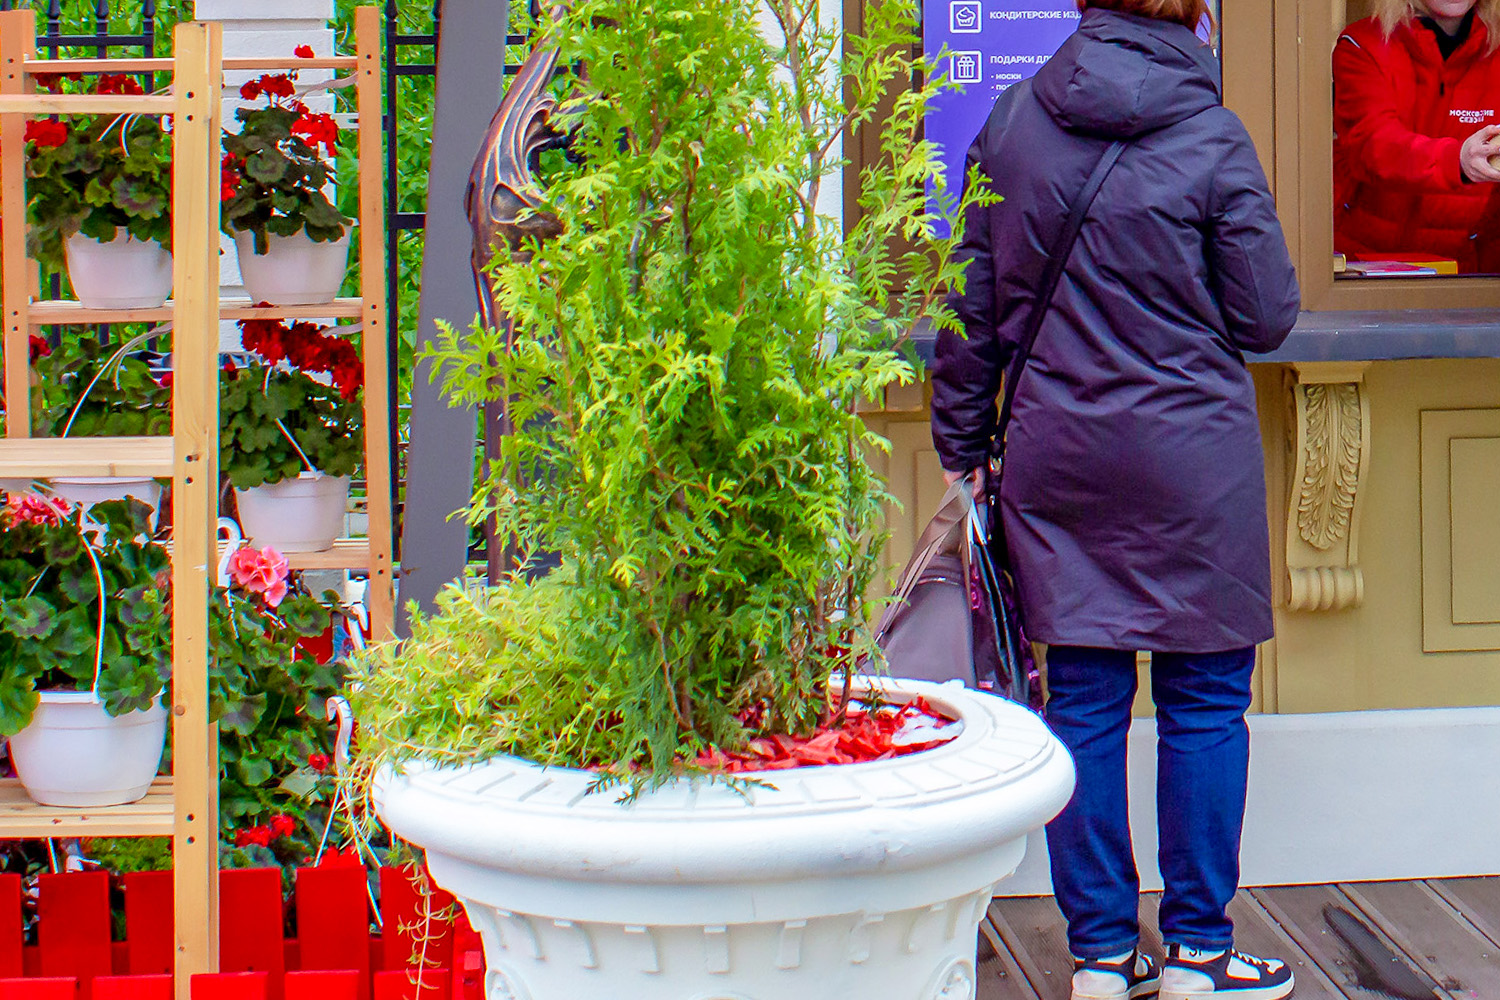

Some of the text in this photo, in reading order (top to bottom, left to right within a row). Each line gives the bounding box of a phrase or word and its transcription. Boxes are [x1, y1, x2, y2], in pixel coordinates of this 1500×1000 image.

[989, 10, 1083, 20] КОНДИТЕРСКИЕ ИЗД
[990, 56, 1052, 66] ПОДАРКИ ДЛ
